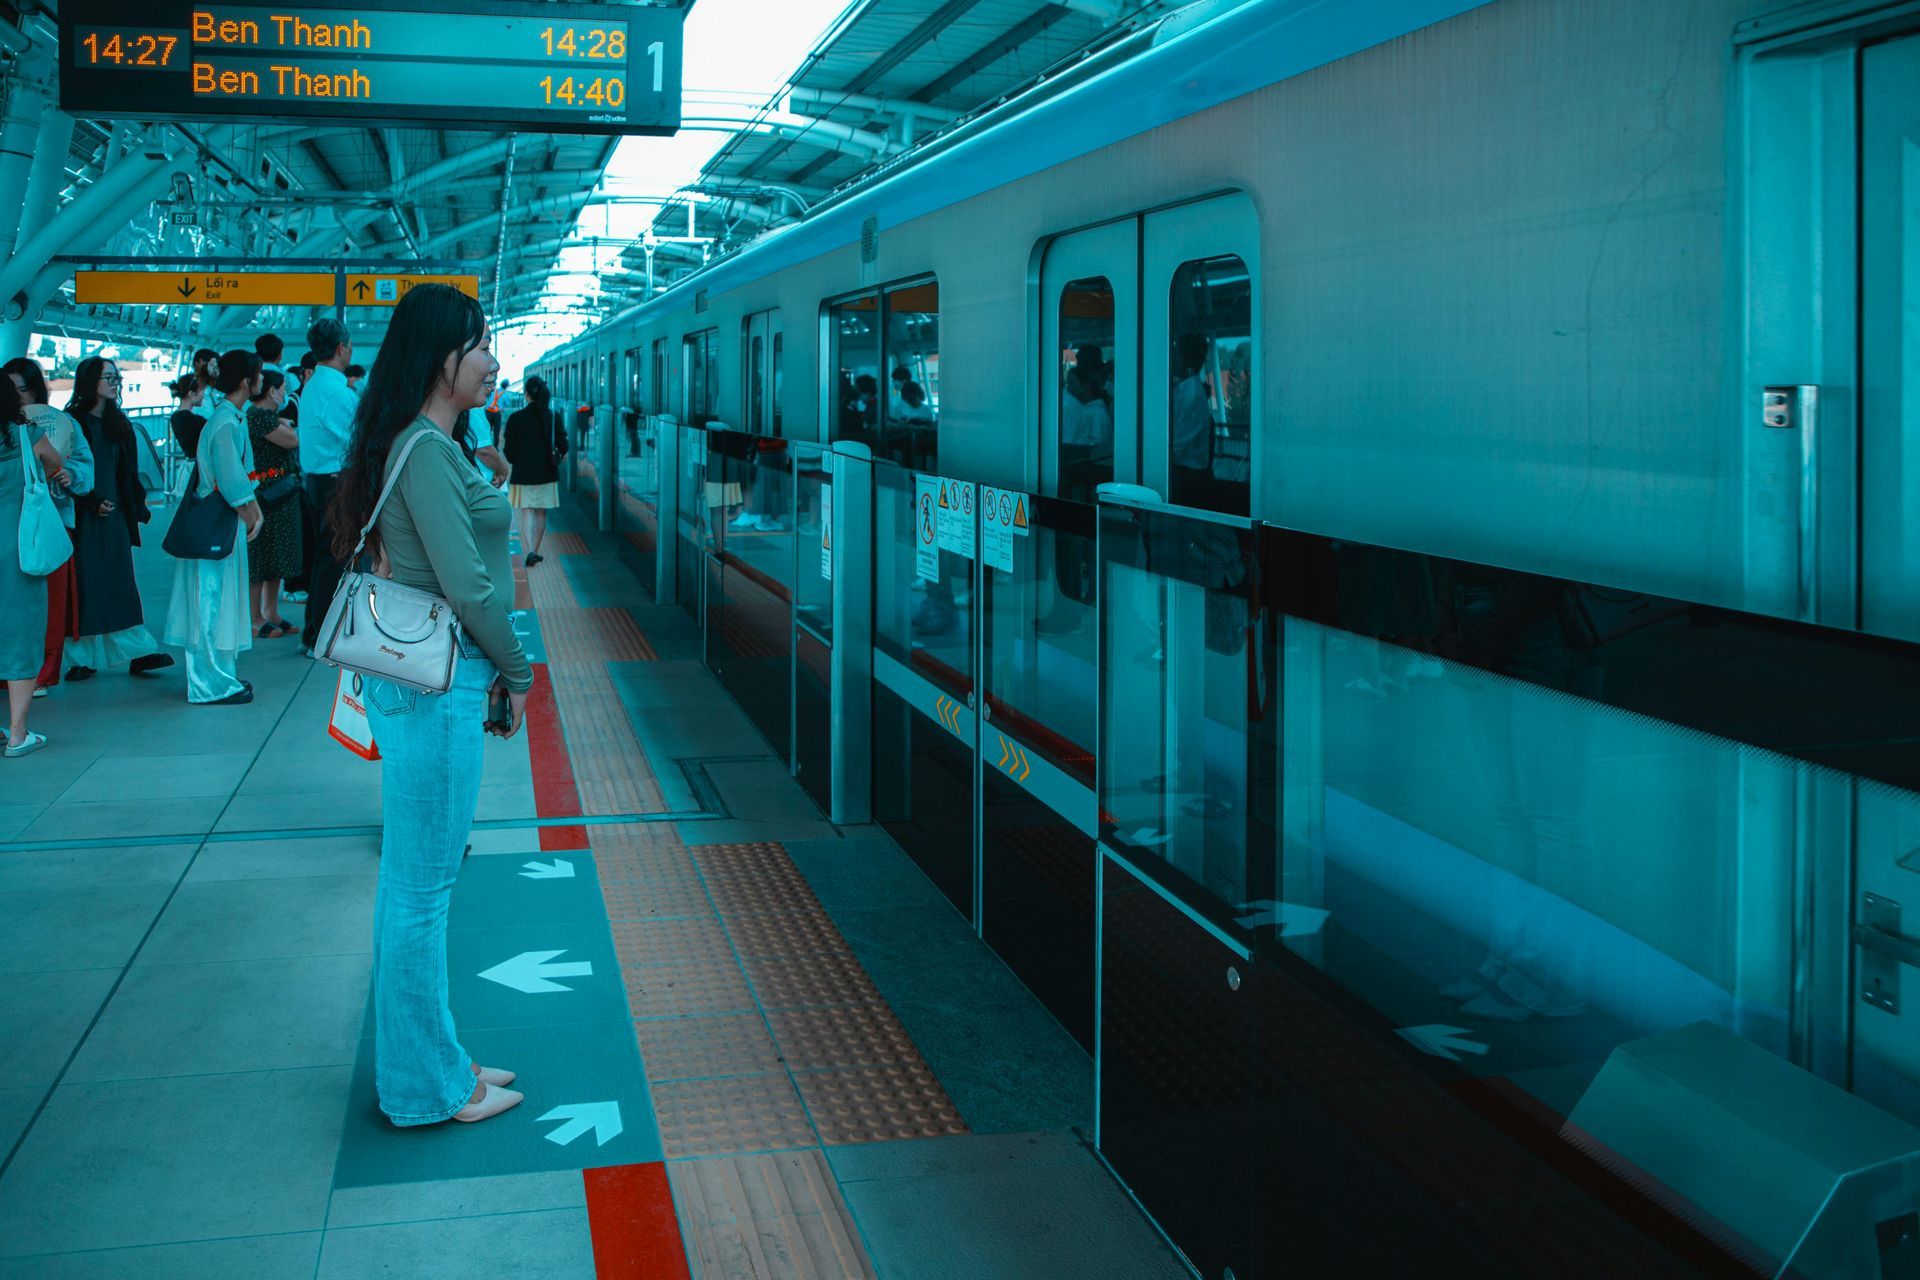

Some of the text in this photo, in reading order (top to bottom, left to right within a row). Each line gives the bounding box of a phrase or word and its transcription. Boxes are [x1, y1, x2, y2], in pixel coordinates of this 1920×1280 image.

[193, 12, 371, 48] Ben Thanh
[540, 28, 625, 58] 14:28
[83, 33, 177, 65] 14:27
[193, 63, 370, 98] Ben Thanh
[647, 41, 664, 92] 1
[539, 76, 625, 107] 14:40
[175, 214, 194, 223] EXIT
[206, 291, 222, 299] Exit
[226, 280, 239, 289] ra
